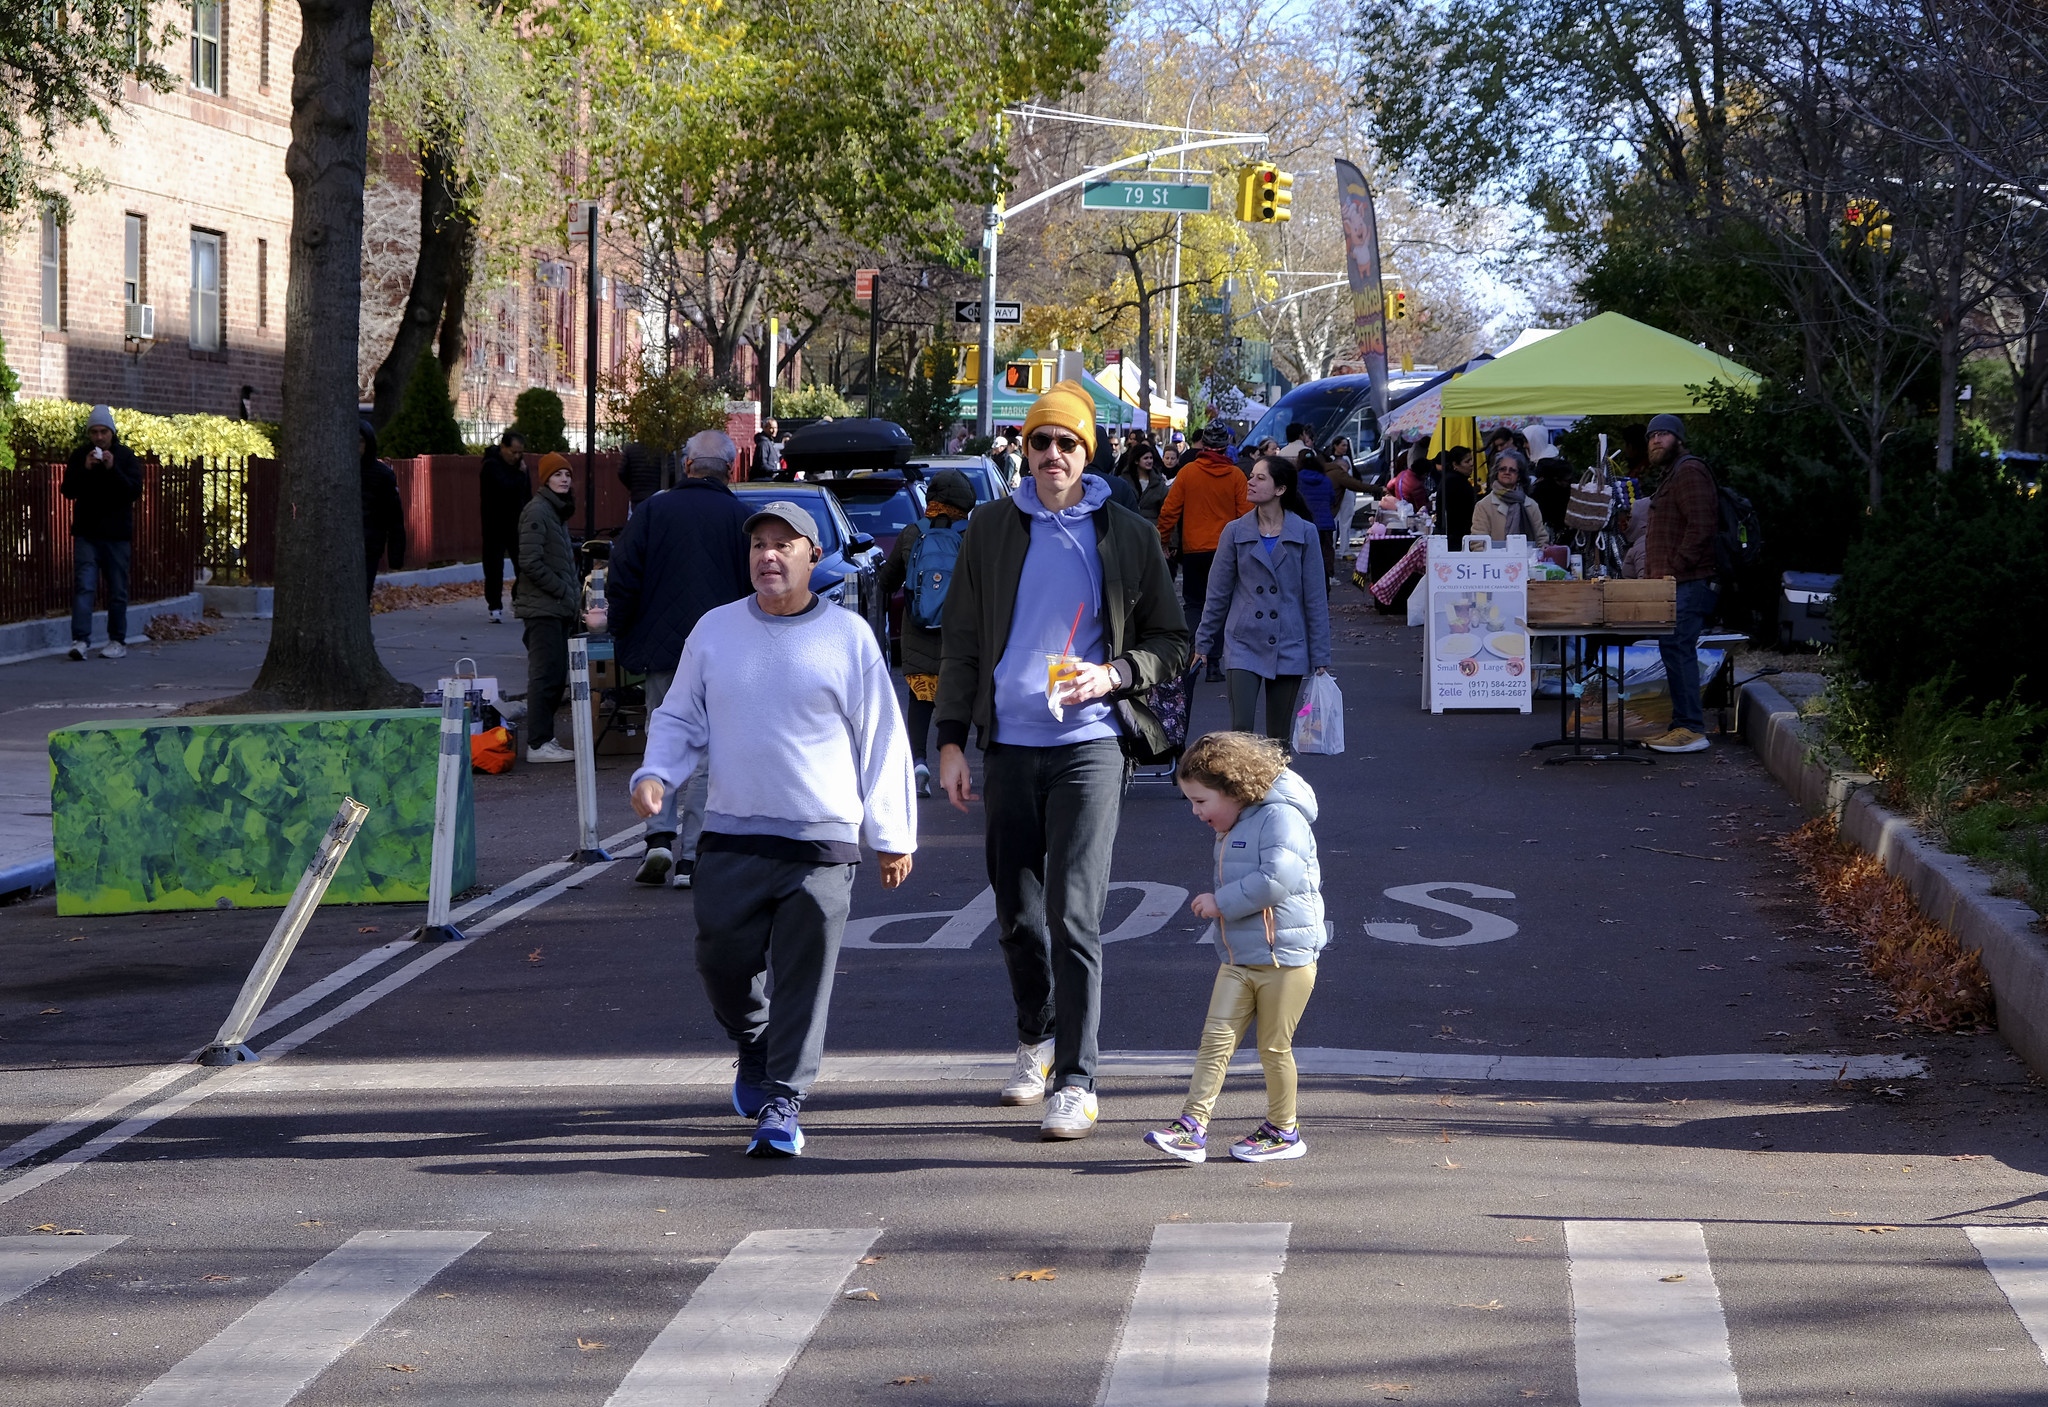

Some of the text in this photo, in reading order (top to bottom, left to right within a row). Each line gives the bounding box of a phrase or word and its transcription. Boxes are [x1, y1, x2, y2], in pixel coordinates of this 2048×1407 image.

[1124, 186, 1169, 206] 79 St
[967, 308, 1014, 317] ON WAY
[1000, 406, 1028, 417] MARKE
[1483, 564, 1501, 580] Fu
[1437, 664, 1504, 672] Small Large
[1438, 687, 1463, 697] Zelle
[842, 881, 1518, 950] SOP
